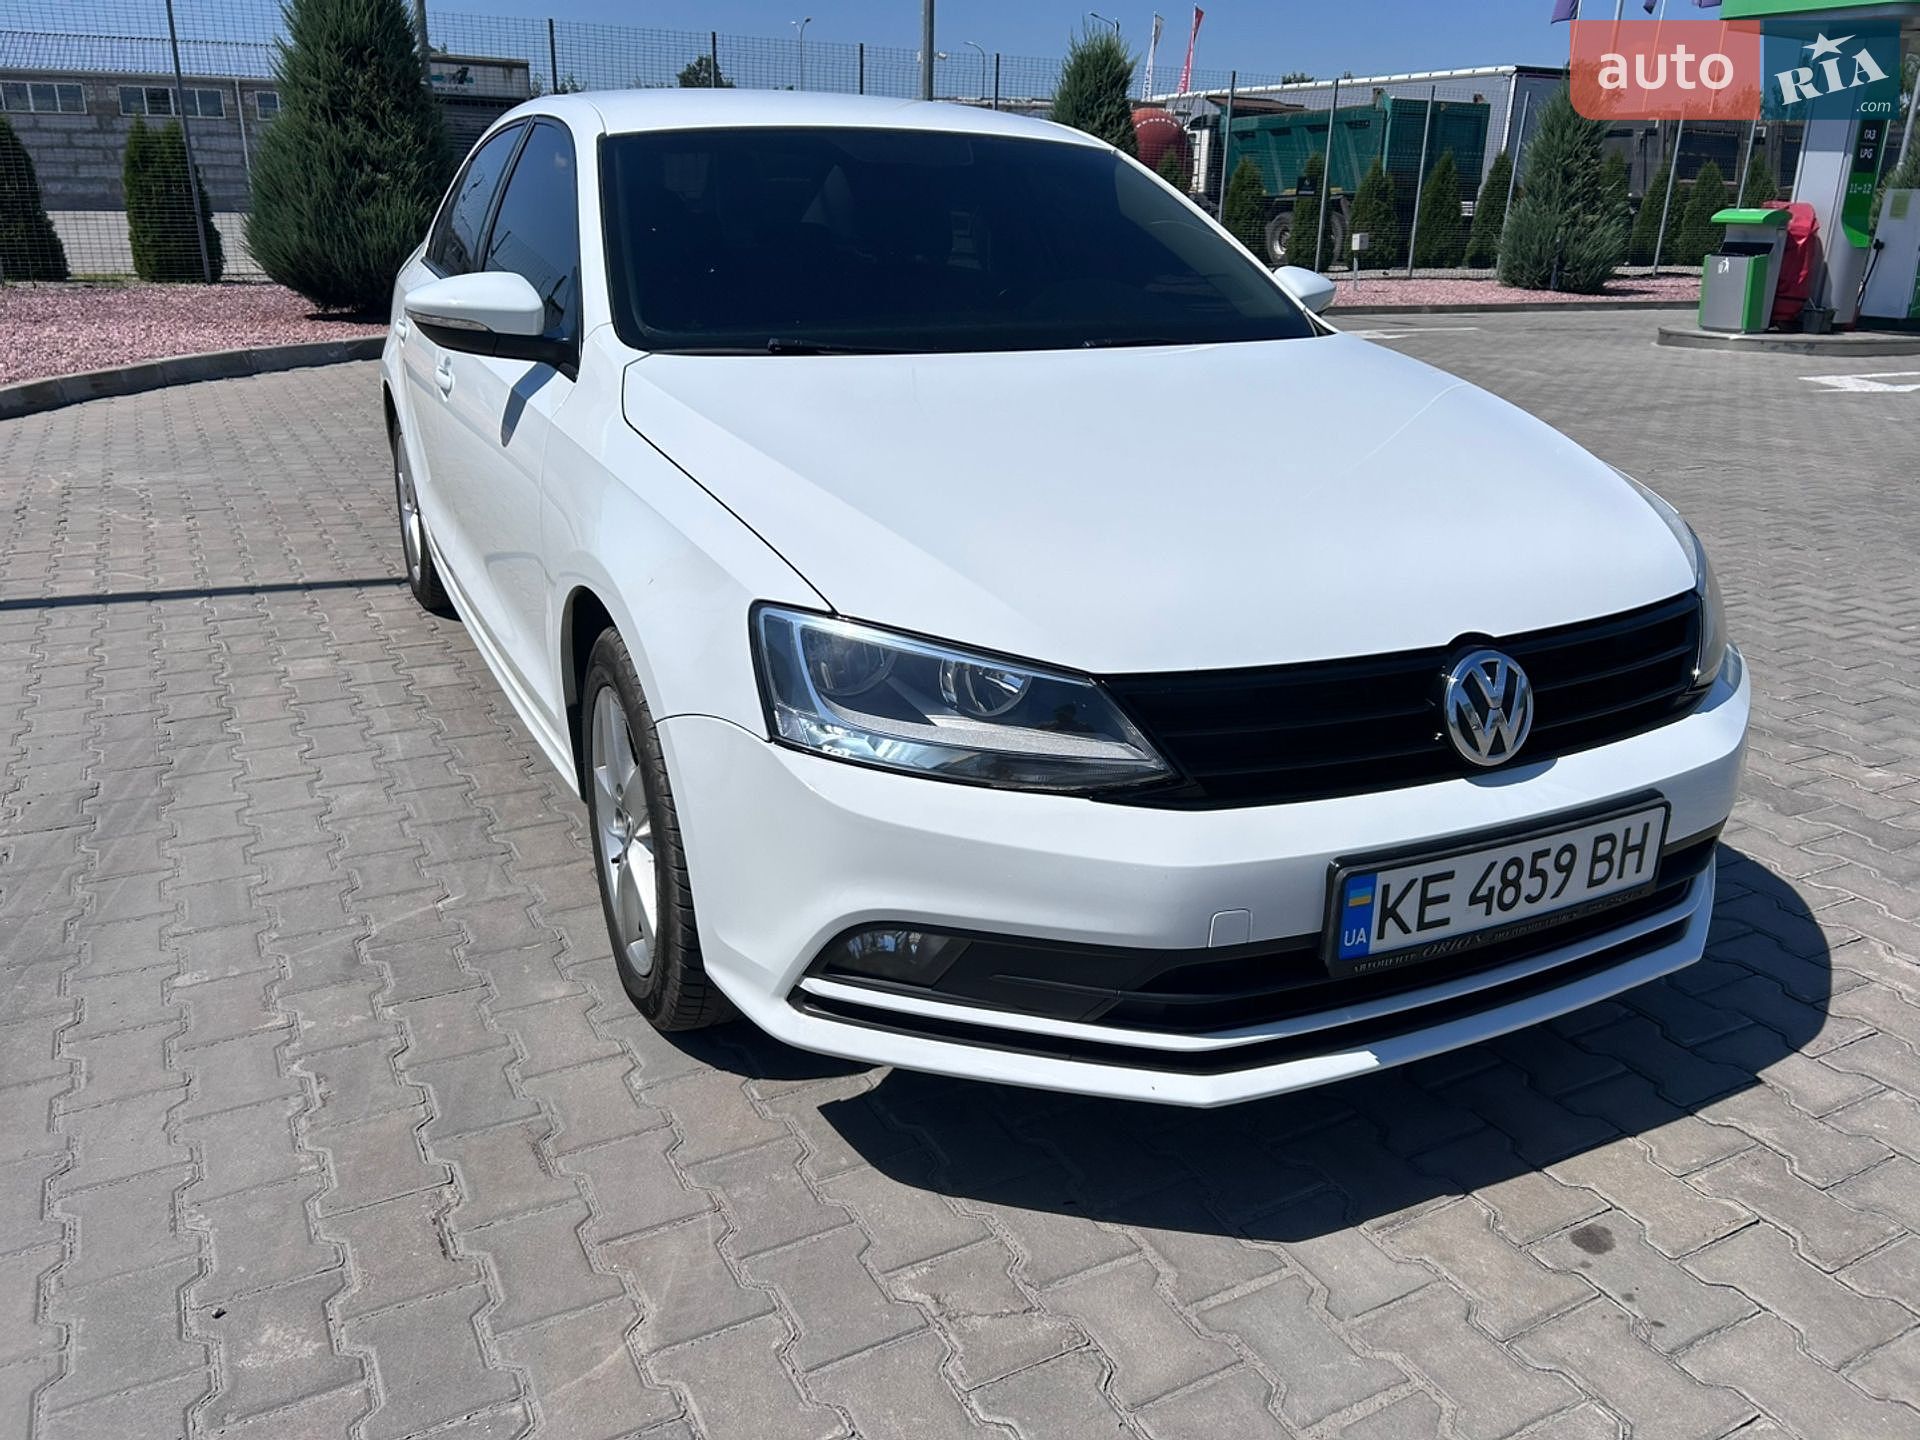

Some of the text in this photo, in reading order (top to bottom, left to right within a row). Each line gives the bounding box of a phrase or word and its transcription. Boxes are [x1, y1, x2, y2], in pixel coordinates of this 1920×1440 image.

[1849, 183, 1873, 195] 11-12
[1376, 870, 1456, 940] KE
[1468, 843, 1578, 916] 4859
[1586, 822, 1651, 889] BH
[1344, 927, 1367, 947] UA
